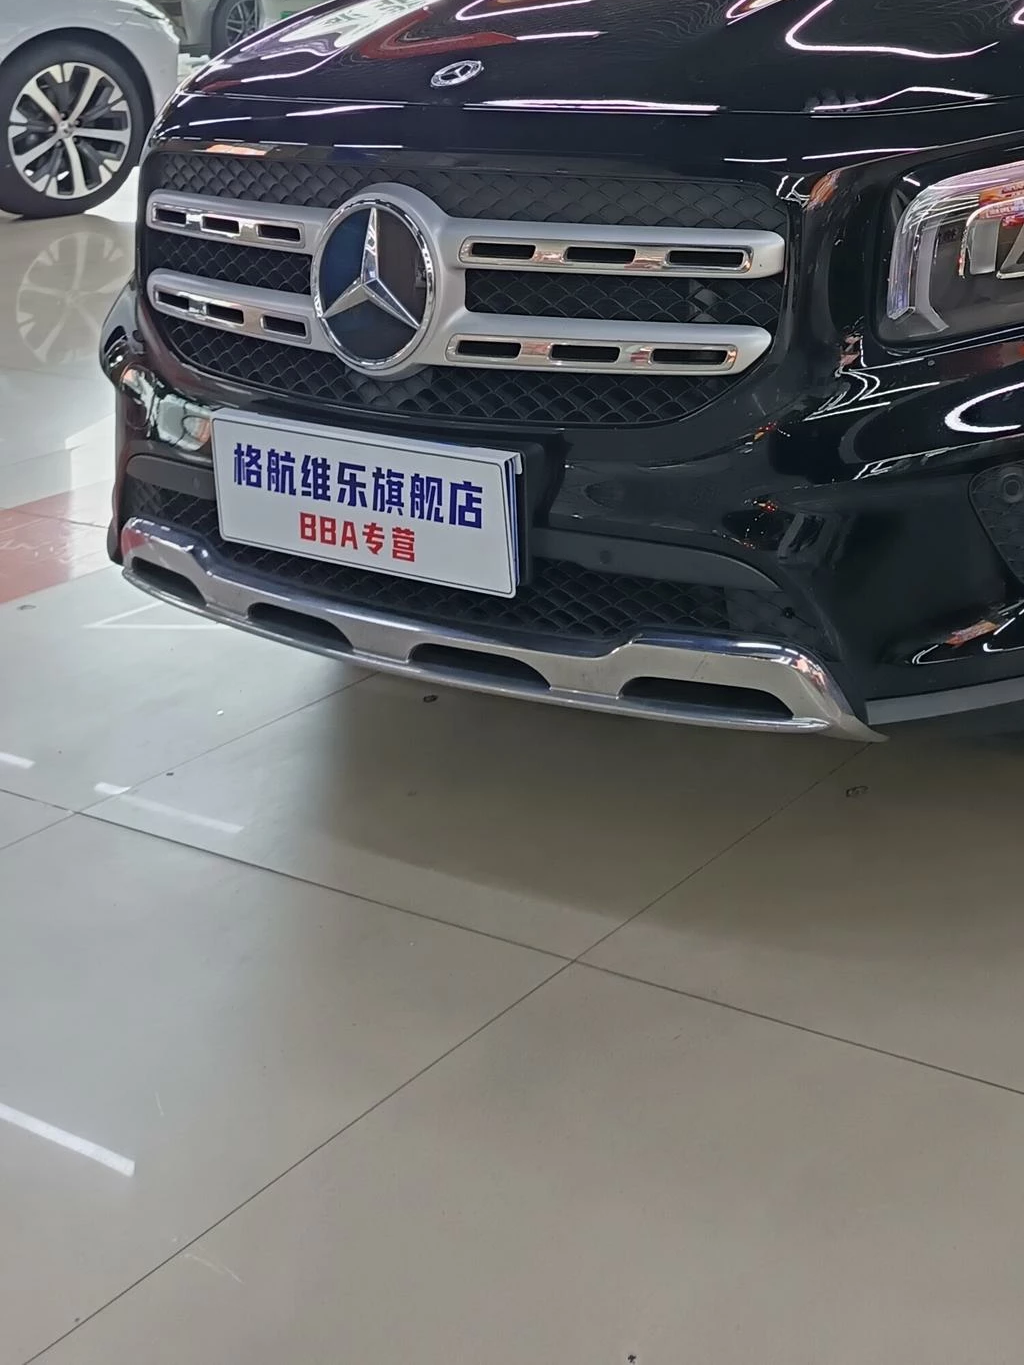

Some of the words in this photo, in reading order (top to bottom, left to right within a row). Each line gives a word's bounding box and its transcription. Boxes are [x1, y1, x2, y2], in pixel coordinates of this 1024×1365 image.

[233, 442, 483, 529] 格航维乐旗舰店
[299, 511, 416, 563] BBA专营
